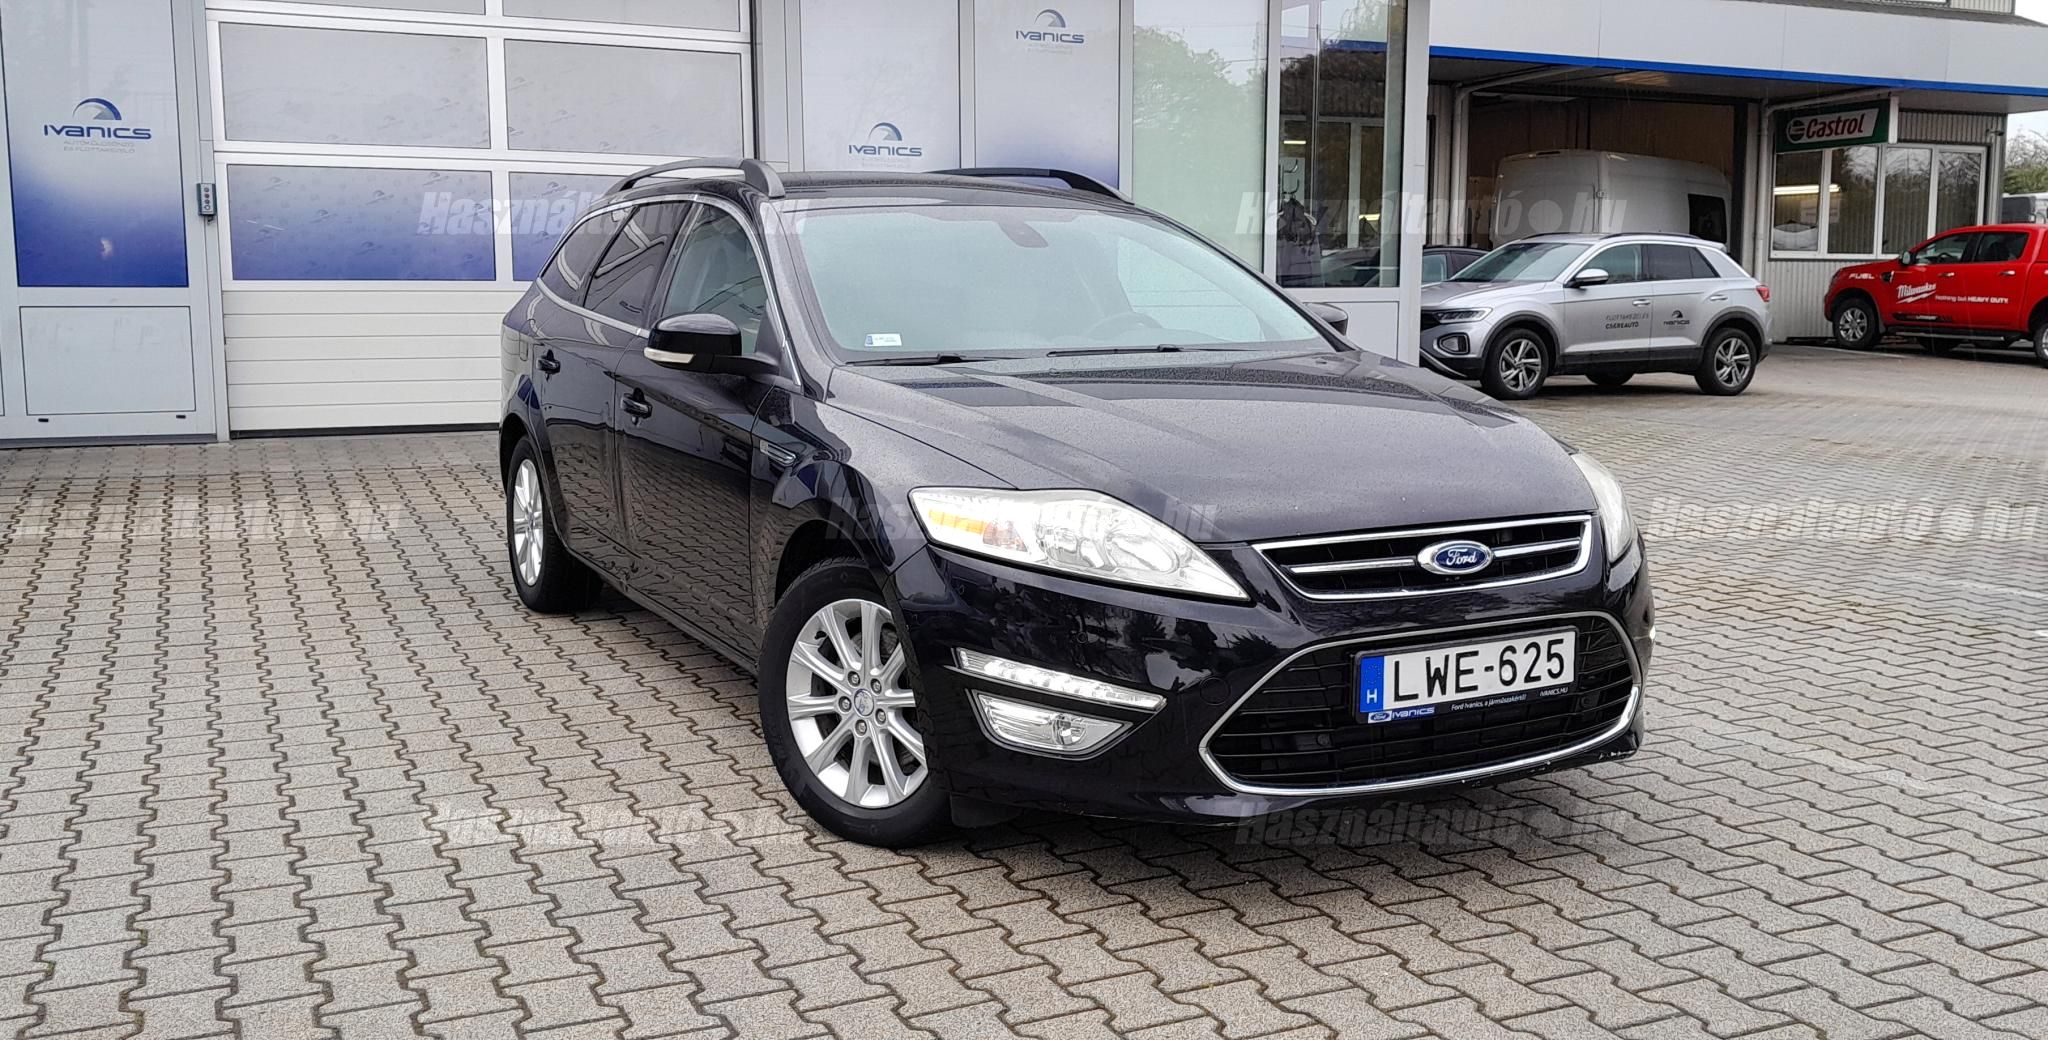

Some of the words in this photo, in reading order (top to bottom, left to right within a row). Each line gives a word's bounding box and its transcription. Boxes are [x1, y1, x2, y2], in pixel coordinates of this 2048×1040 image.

[1806, 113, 1866, 139] Castrol
[1896, 282, 1937, 299] Milwaukee
[1967, 295, 1990, 303] HEAVY
[1446, 548, 1478, 566] Ford
[1393, 638, 1565, 703] LWE-625
[1366, 688, 1378, 704] H
[1451, 703, 1464, 711] Ford
